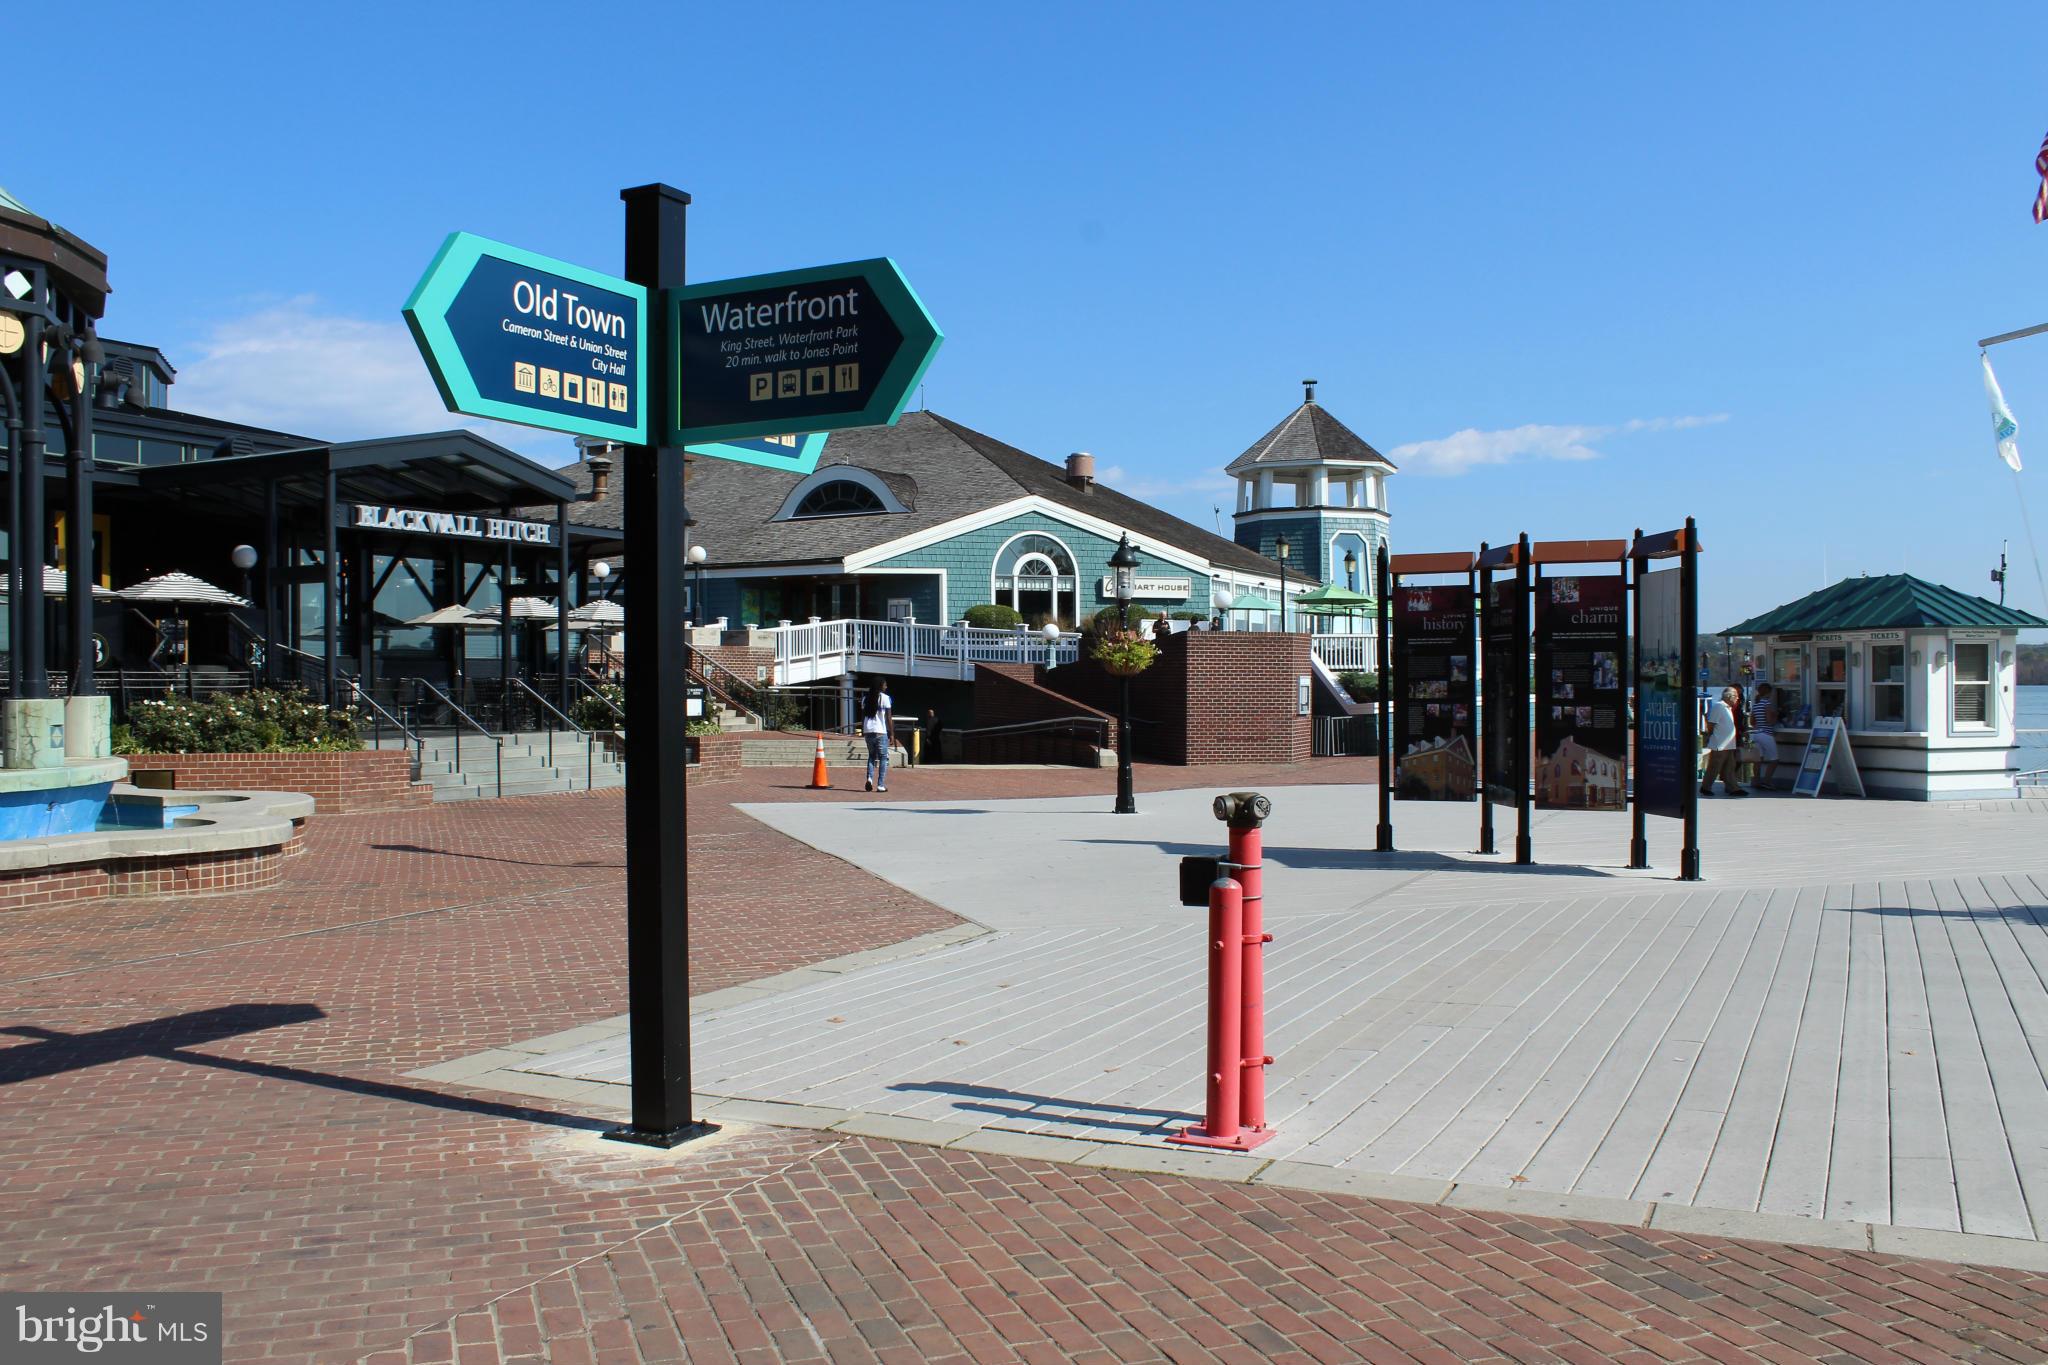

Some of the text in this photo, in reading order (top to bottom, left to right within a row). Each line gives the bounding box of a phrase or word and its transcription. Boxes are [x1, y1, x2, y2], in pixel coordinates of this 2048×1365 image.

[513, 280, 625, 339] Old Town
[702, 288, 859, 334] Waterfront
[502, 319, 628, 361] Cameron Street & Union Street
[721, 325, 858, 353] King Street, Waterfront Park
[592, 358, 626, 377] City Hall
[725, 342, 859, 368] 20 min. walk to Jones Point
[756, 377, 768, 397] P
[355, 504, 550, 544] BLACKWALL HITCH
[1423, 616, 1465, 634] history
[1571, 608, 1618, 624] charm
[1870, 632, 1899, 640] TICKETS
[1647, 699, 1678, 717] water
[1643, 708, 1678, 741] front
